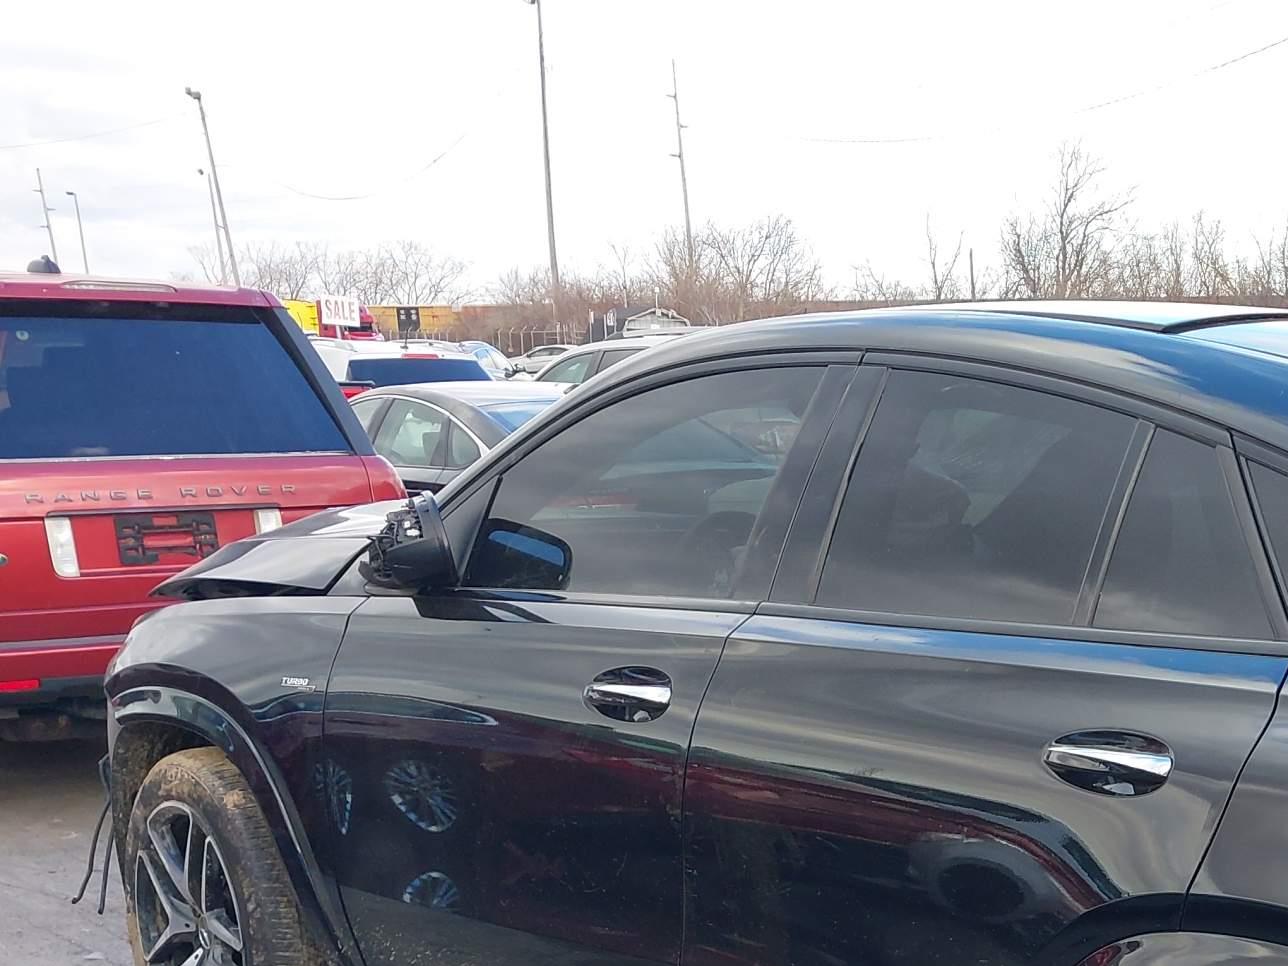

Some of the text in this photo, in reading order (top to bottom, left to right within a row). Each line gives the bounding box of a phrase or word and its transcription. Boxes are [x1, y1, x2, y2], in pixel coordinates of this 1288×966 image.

[324, 299, 356, 322] SALE
[24, 484, 297, 504] RANGE ROVER
[281, 676, 309, 686] TURBO
